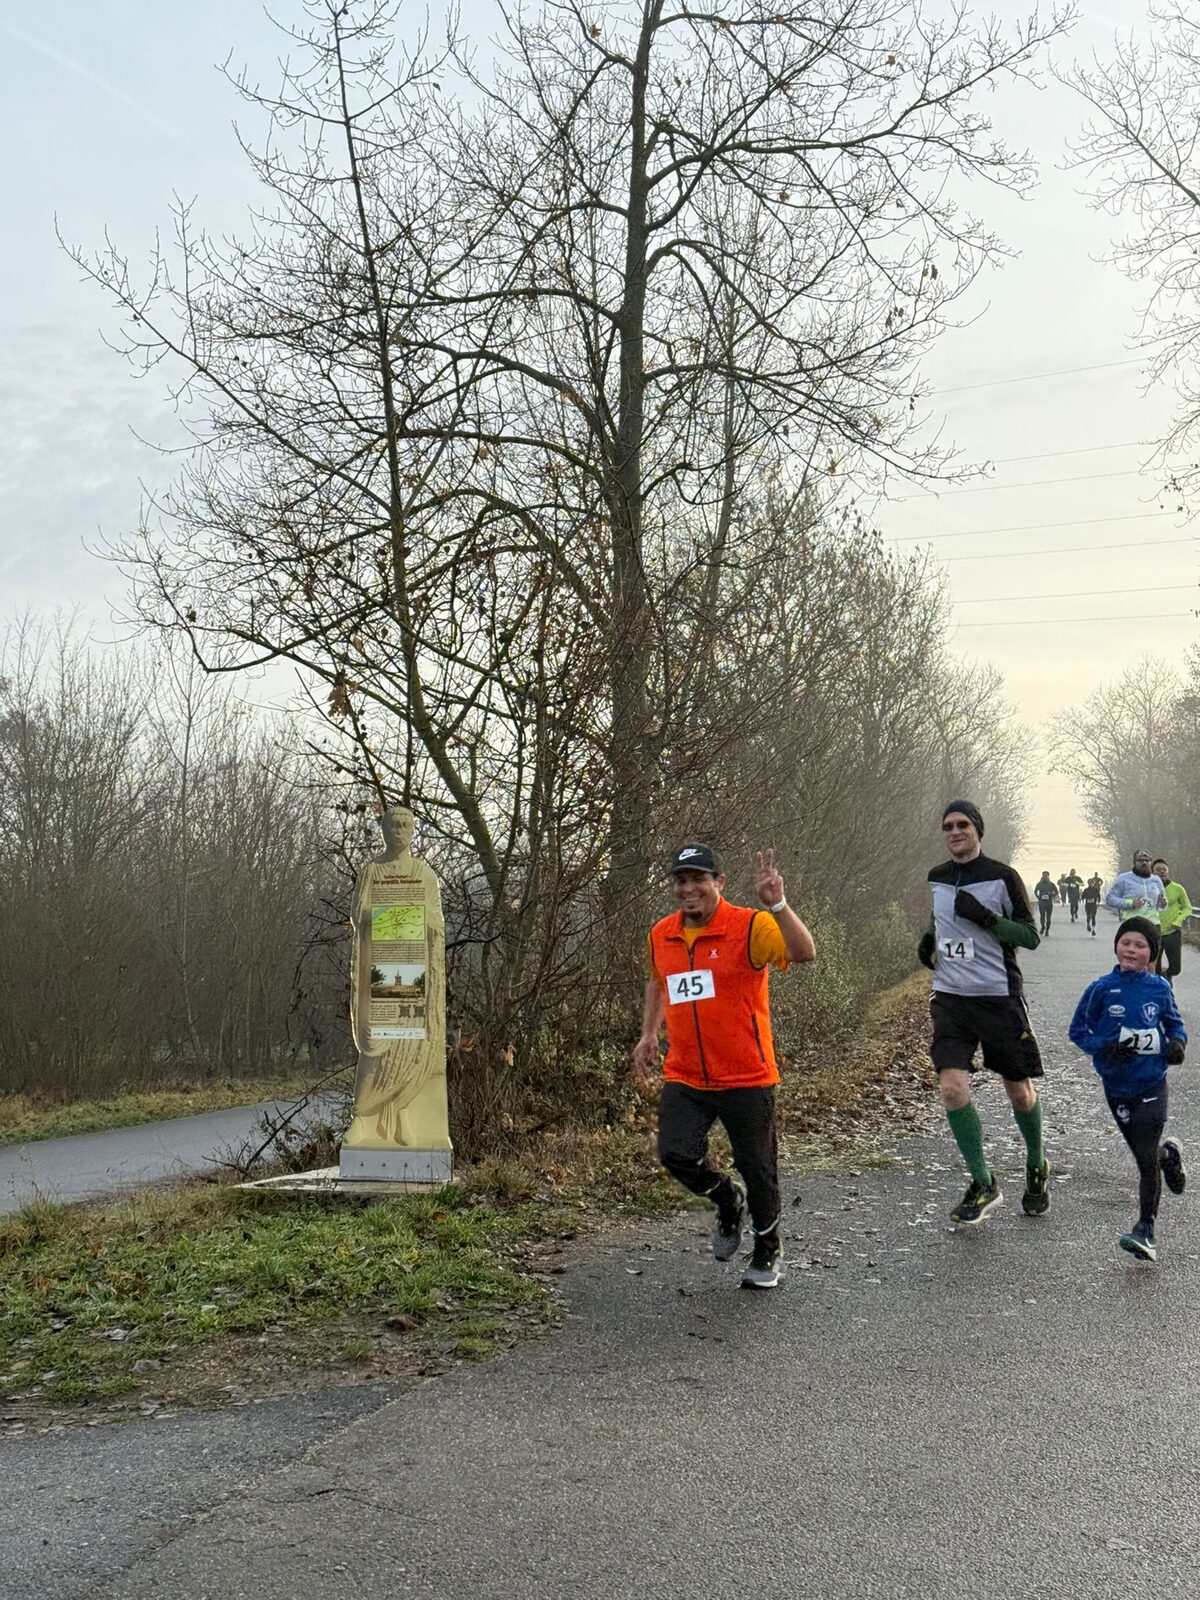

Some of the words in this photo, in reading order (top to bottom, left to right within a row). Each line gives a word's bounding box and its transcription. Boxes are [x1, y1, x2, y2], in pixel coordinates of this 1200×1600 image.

[945, 942, 966, 958] 14
[677, 975, 703, 997] 45
[1132, 1033, 1153, 1050] 12
